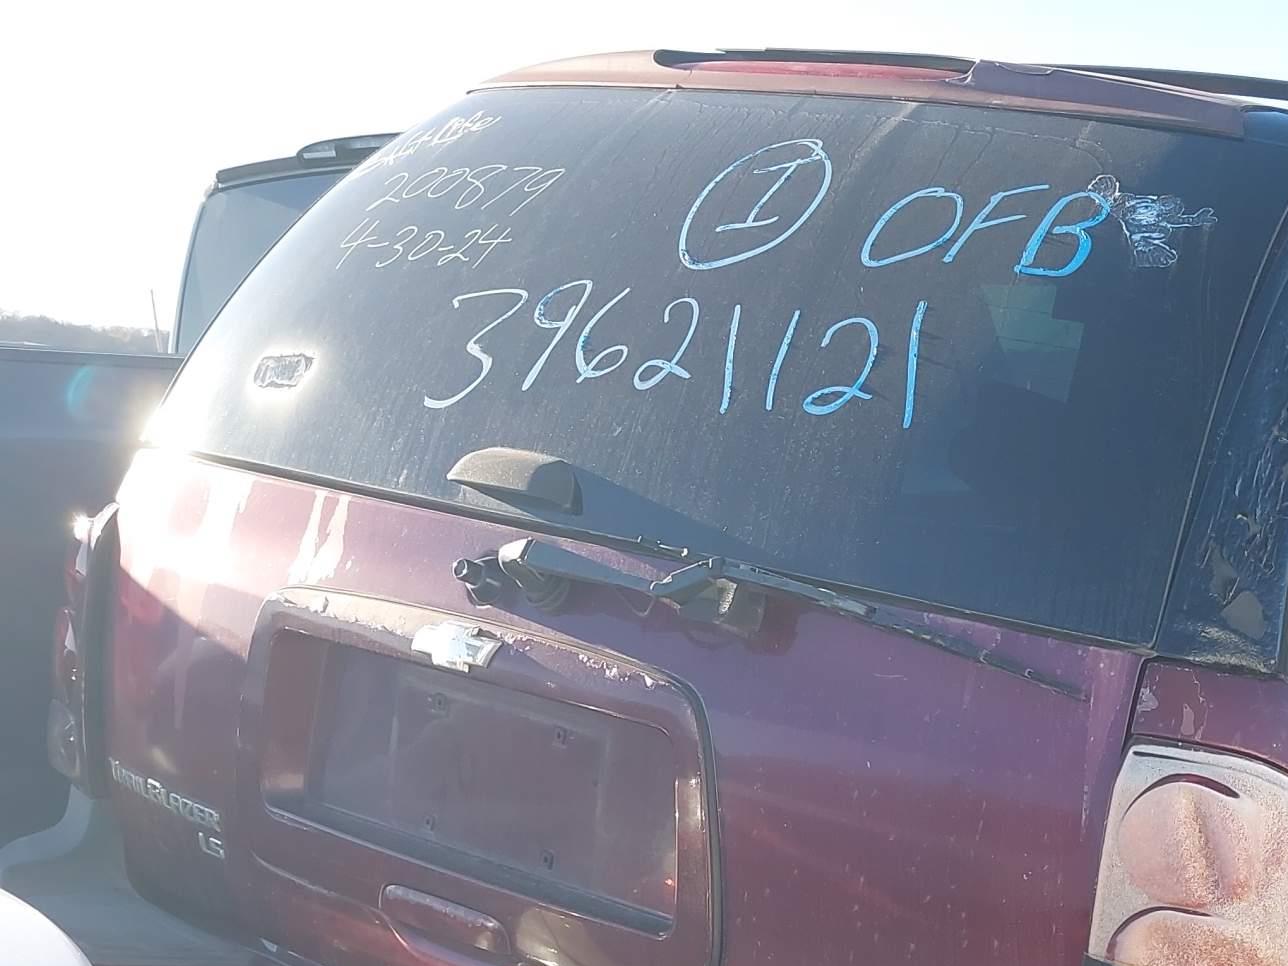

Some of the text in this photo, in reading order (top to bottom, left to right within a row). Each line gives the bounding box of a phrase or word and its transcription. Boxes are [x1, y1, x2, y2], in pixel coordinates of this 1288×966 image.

[366, 163, 566, 216] 200879
[335, 217, 512, 270] 4-30-24
[423, 279, 929, 429] 39621121
